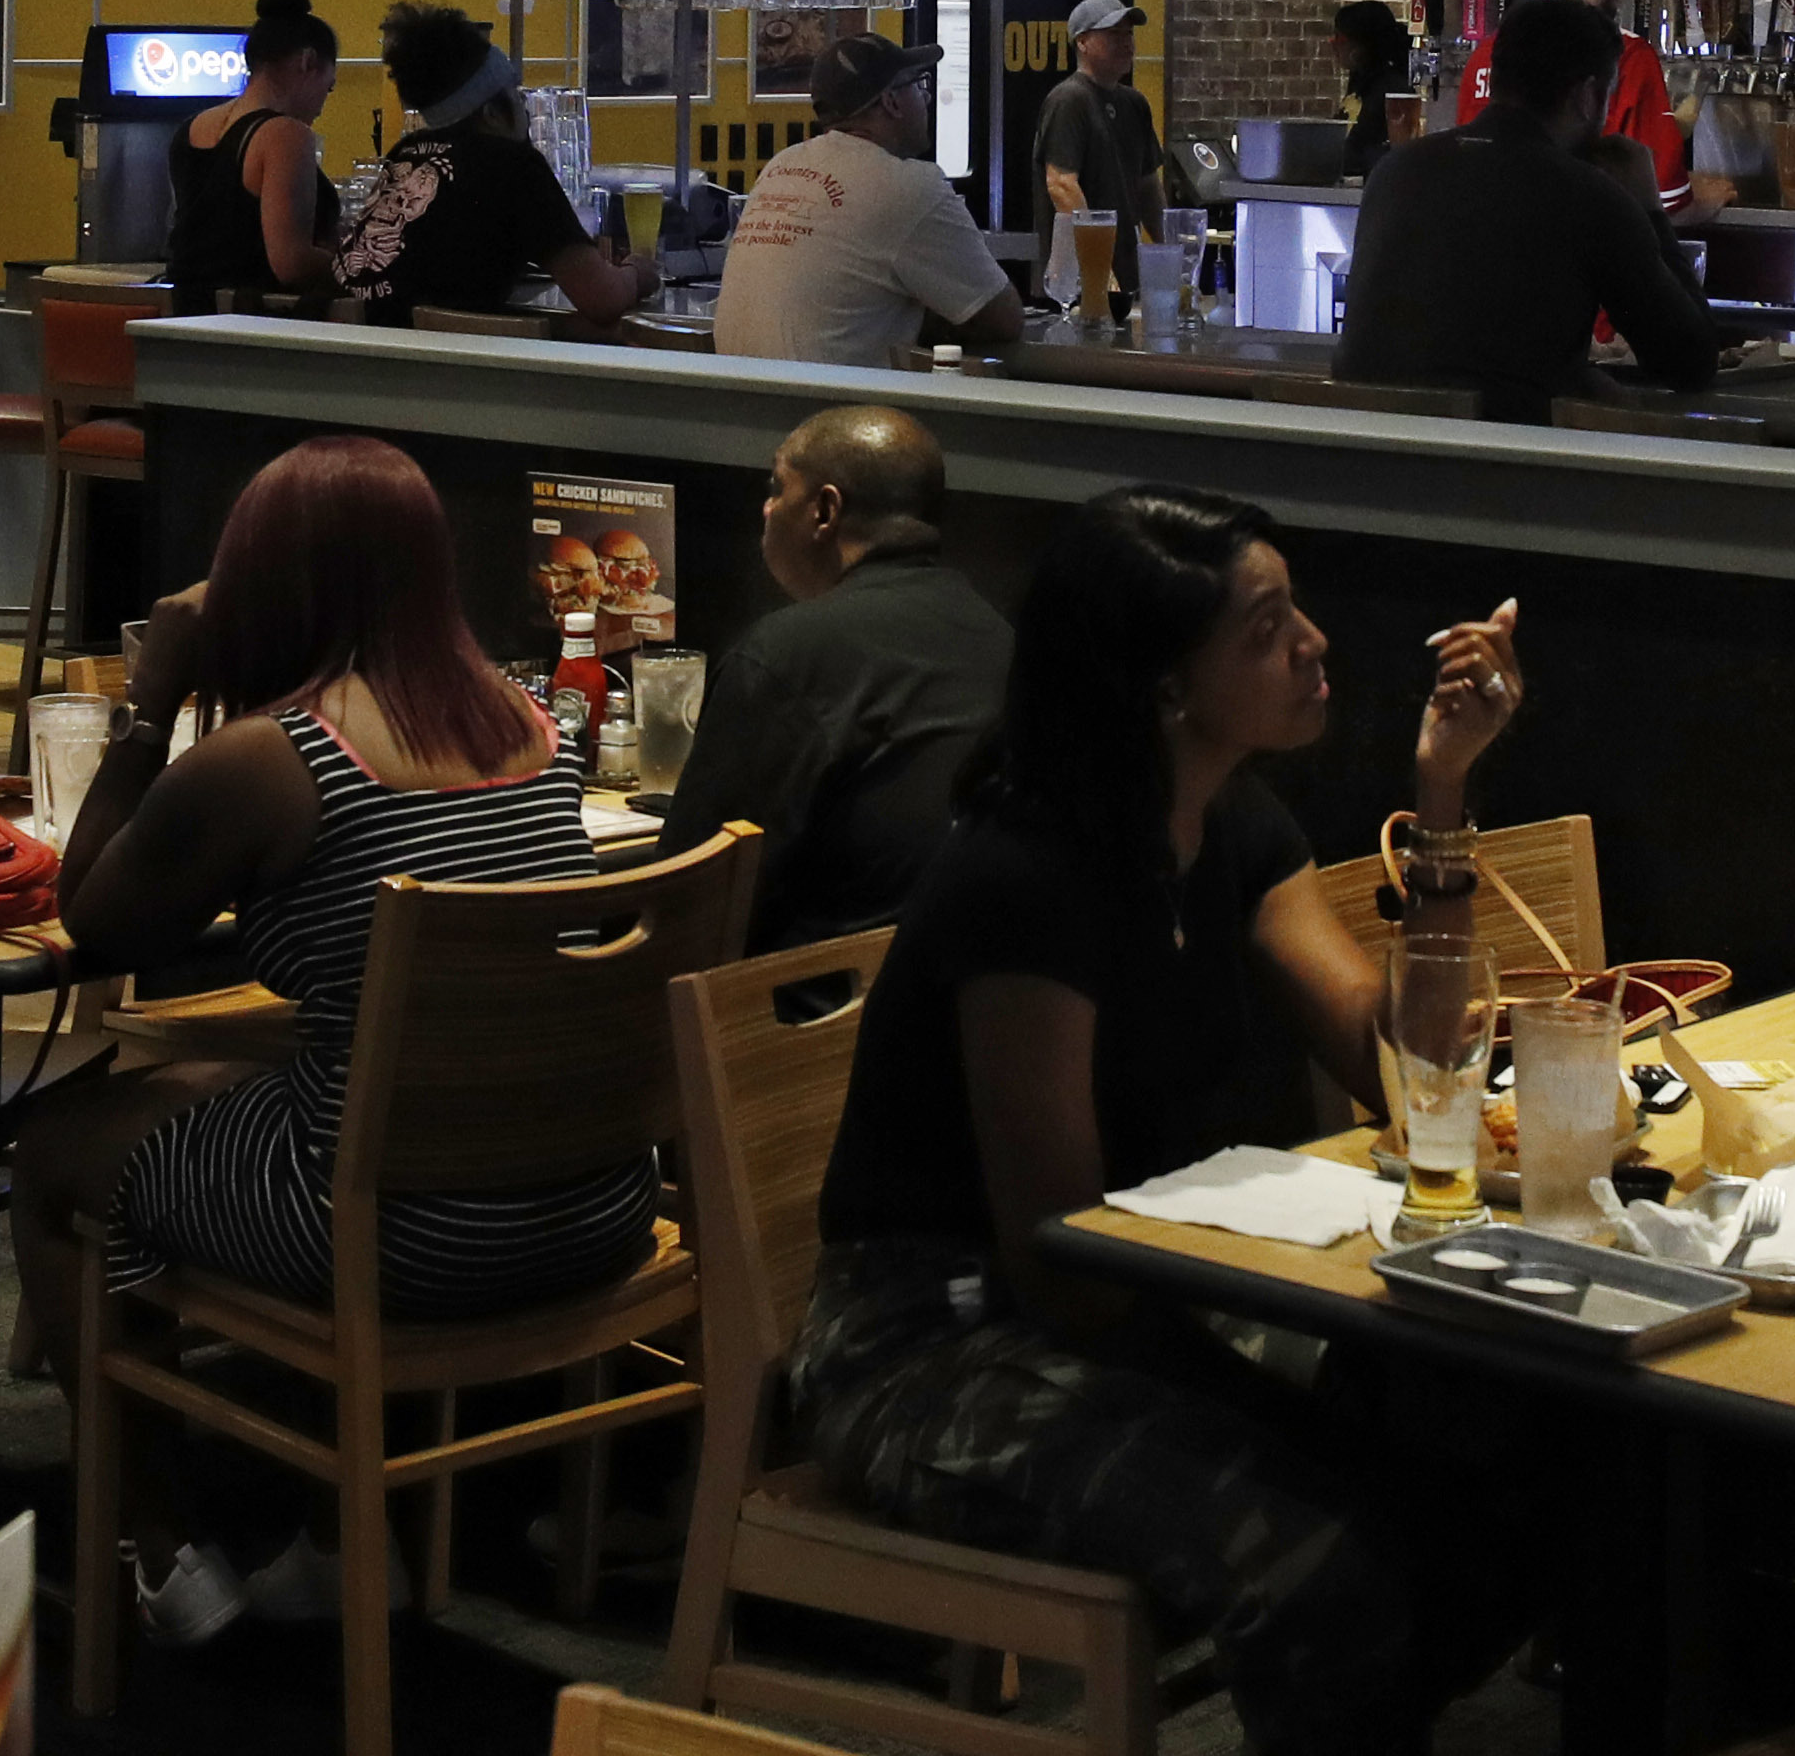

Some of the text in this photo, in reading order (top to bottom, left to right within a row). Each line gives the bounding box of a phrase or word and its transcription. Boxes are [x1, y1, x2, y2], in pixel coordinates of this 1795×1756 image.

[1004, 20, 1074, 73] OUT
[767, 165, 822, 183] Country
[818, 173, 846, 208] Mile
[756, 219, 815, 237] the lowest
[375, 280, 393, 298] US
[533, 481, 556, 496] NEW
[557, 483, 599, 502] CHICKEN
[599, 487, 668, 509] SANDWICHES.
